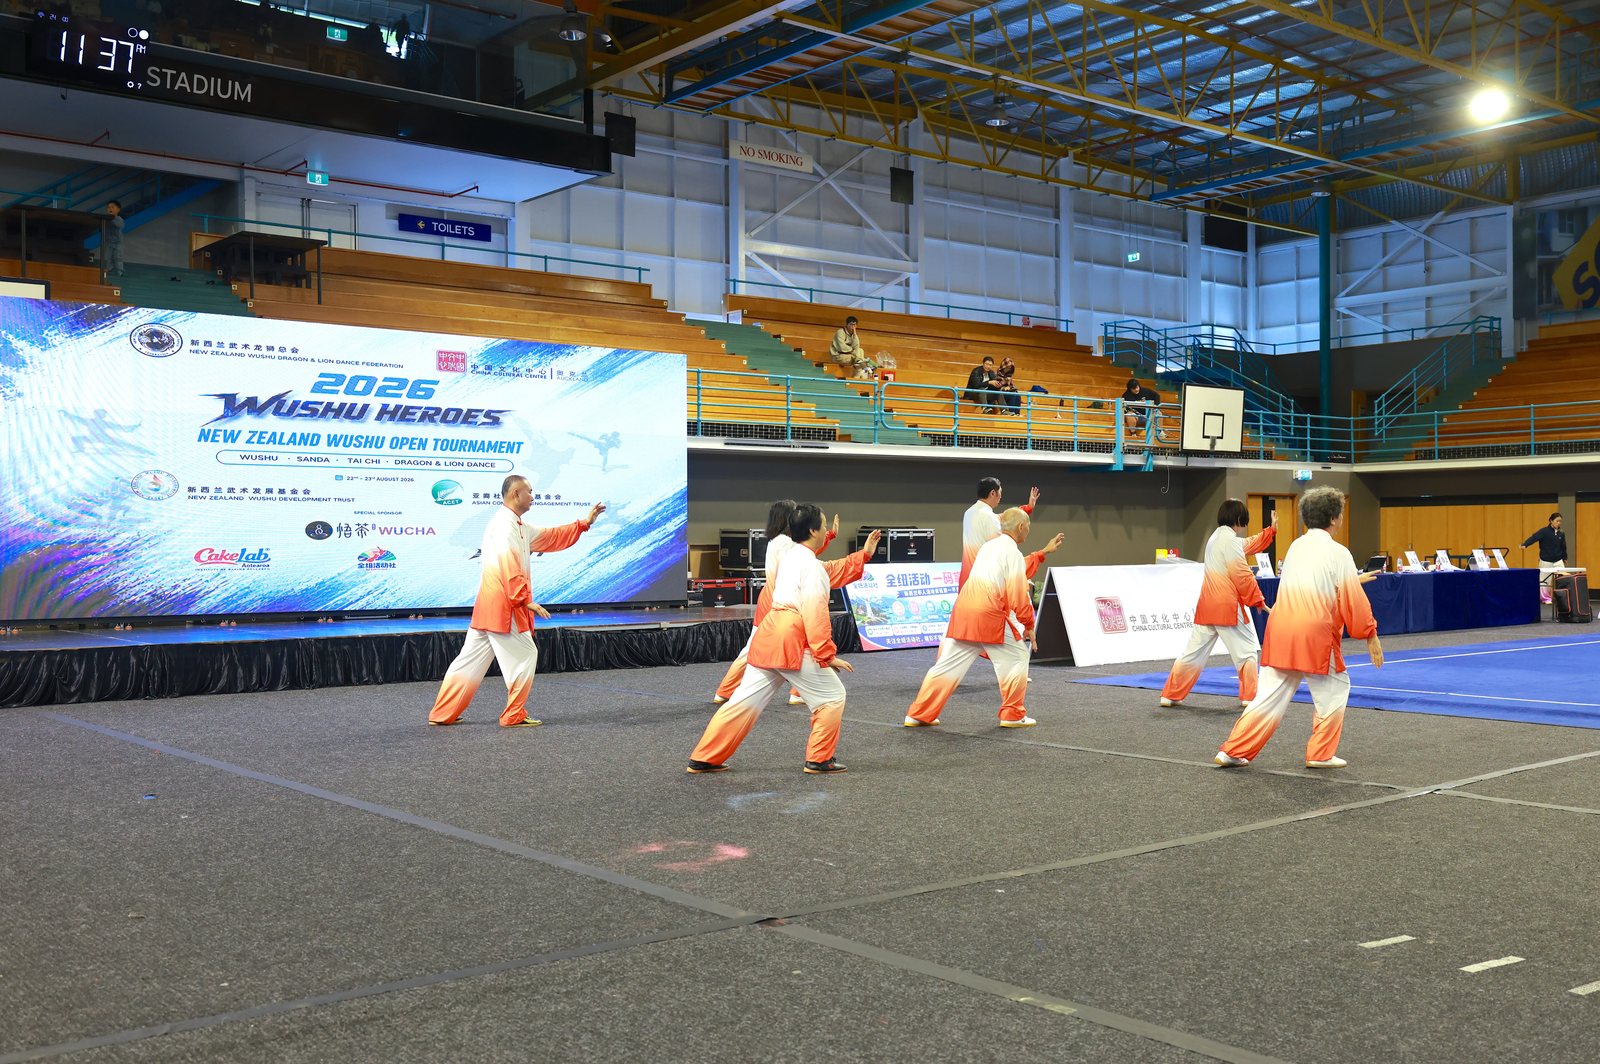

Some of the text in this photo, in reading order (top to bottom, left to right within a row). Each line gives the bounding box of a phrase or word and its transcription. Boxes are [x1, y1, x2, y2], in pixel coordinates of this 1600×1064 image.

[146, 66, 252, 102] STADIUM
[740, 144, 803, 166] NO SMOKING
[432, 222, 475, 236] TOILETS
[471, 364, 547, 375] 中国文化中心
[310, 372, 440, 400] 2026
[197, 428, 524, 454] NEW ZEALAND WUSHU OPEN TOURNAMENT
[187, 486, 311, 495] 新西兰武术发展基金会
[379, 527, 436, 535] WUCHA
[886, 573, 930, 587] 全纽活动
[1130, 612, 1190, 624] 中国文化中心
